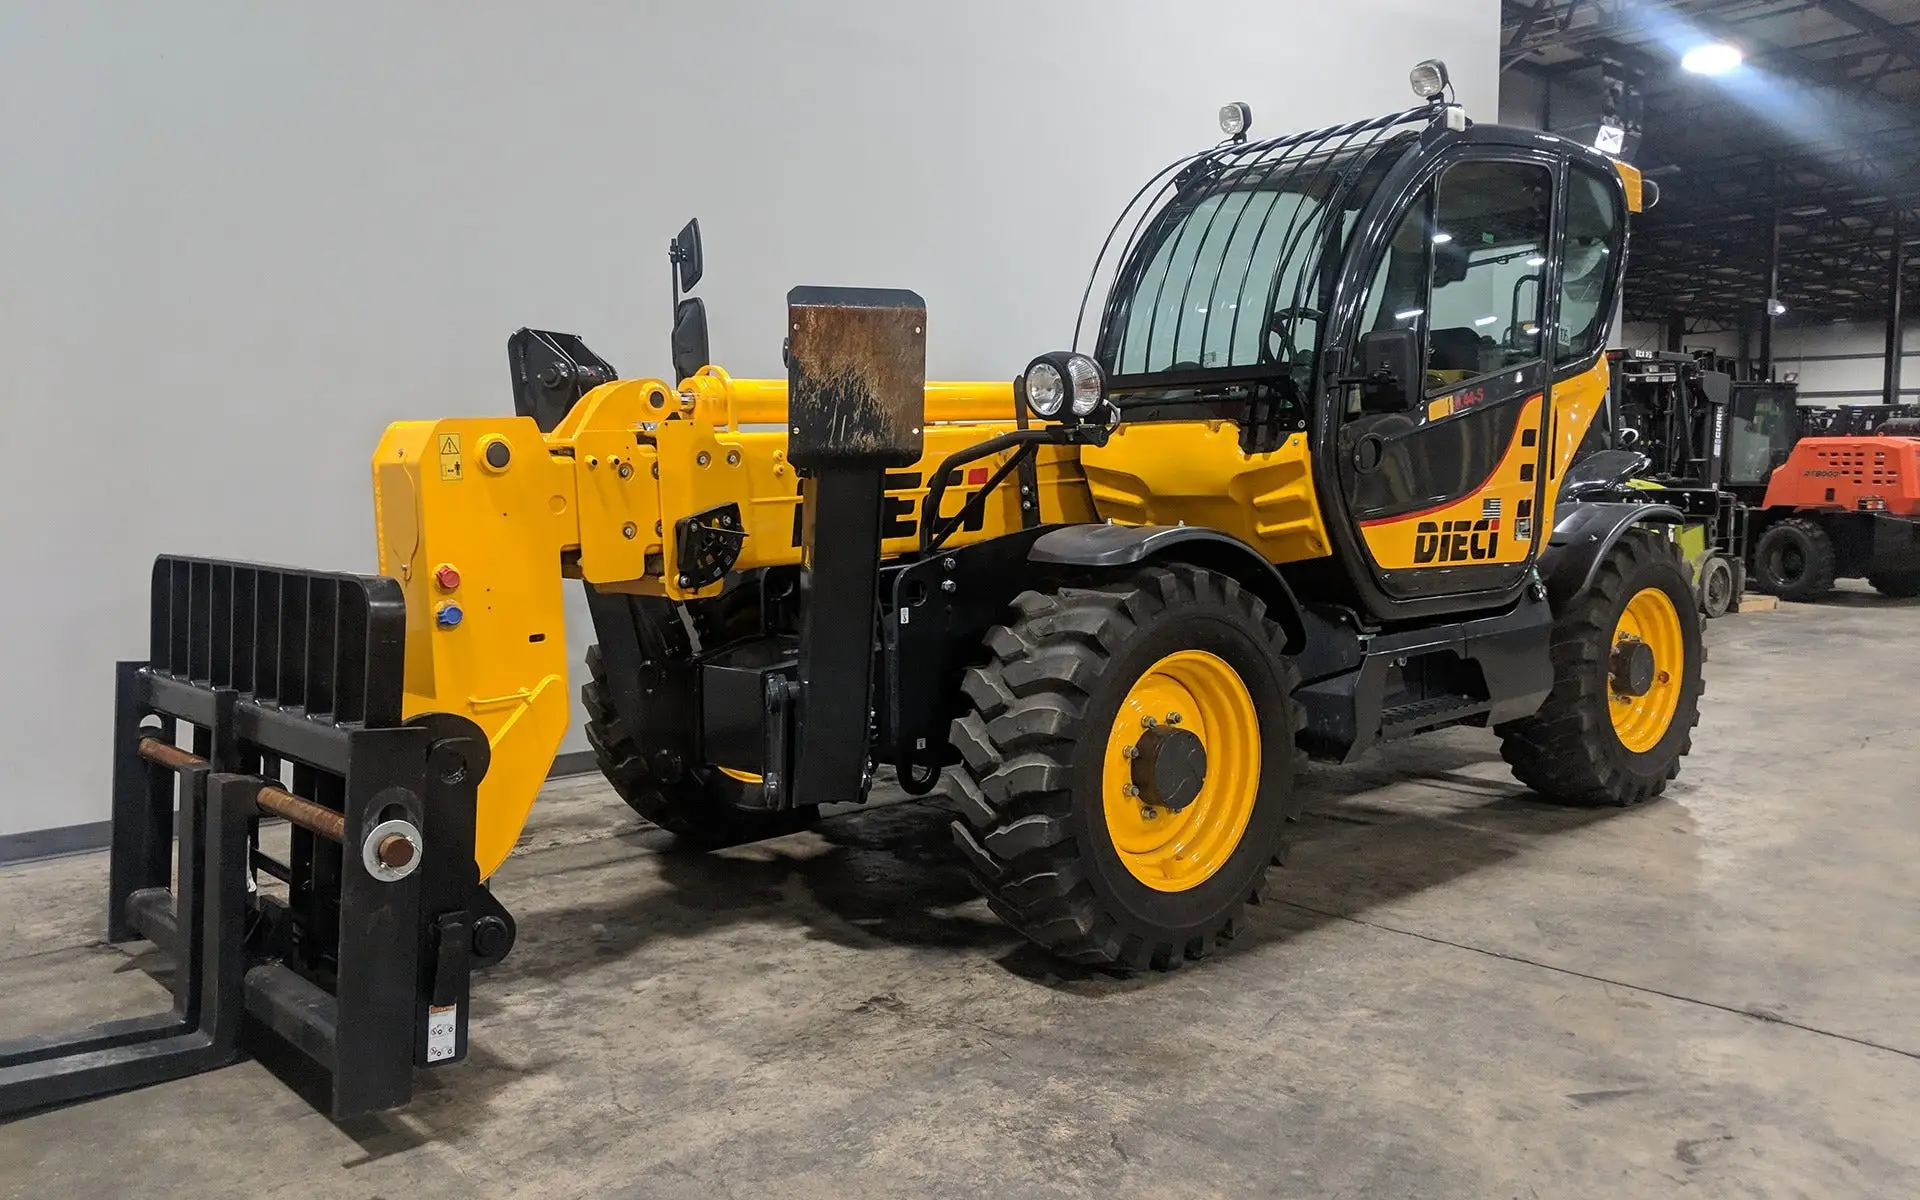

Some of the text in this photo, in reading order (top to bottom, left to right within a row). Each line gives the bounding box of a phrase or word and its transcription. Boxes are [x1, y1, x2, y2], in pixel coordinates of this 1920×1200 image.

[1715, 405, 1723, 439] CLARK
[792, 468, 988, 548] ECI
[1413, 519, 1499, 564] DIECI
